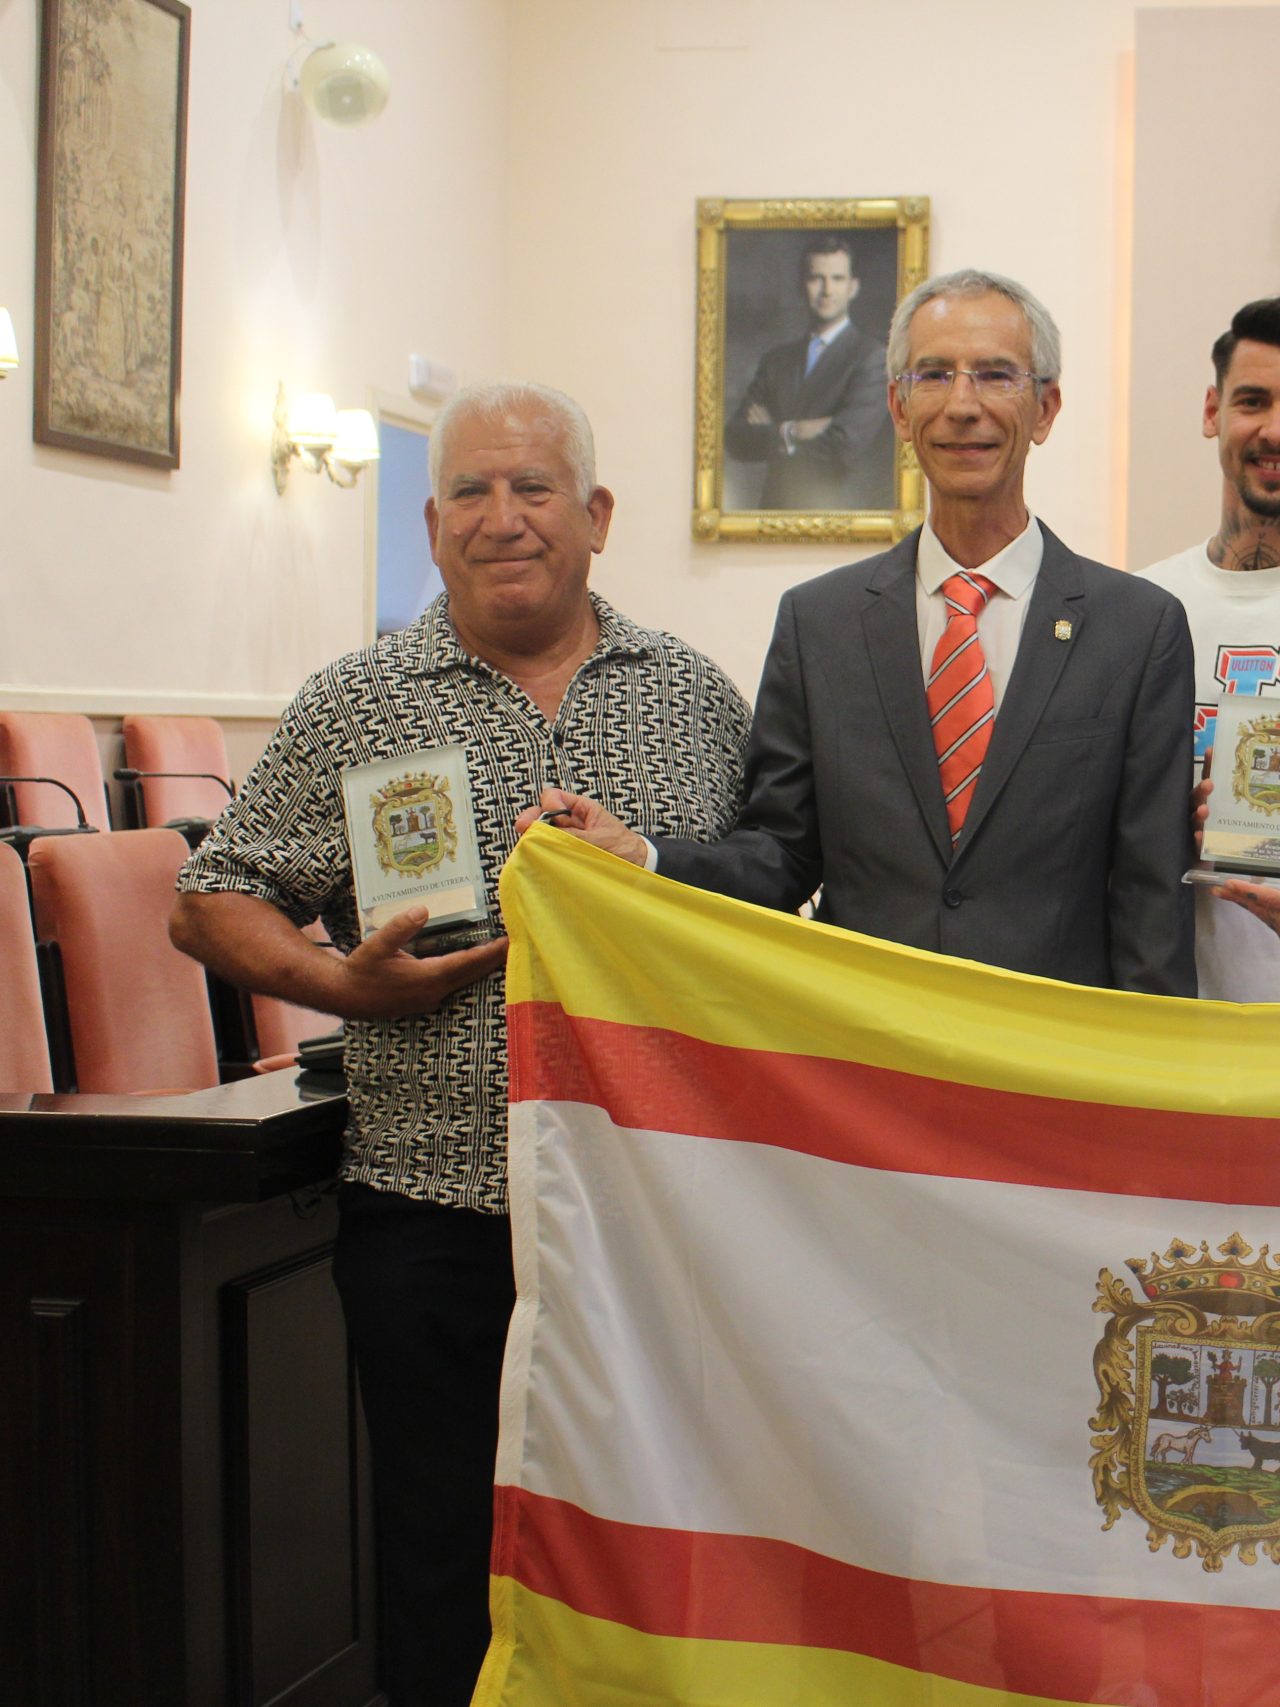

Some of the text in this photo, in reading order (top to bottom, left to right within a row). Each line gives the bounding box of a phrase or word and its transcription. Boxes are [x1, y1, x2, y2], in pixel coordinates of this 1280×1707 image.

[1216, 818, 1275, 831] AYUNTAMIENTO
[371, 875, 470, 903] AYUNTAMIENTO DE UTRERA
